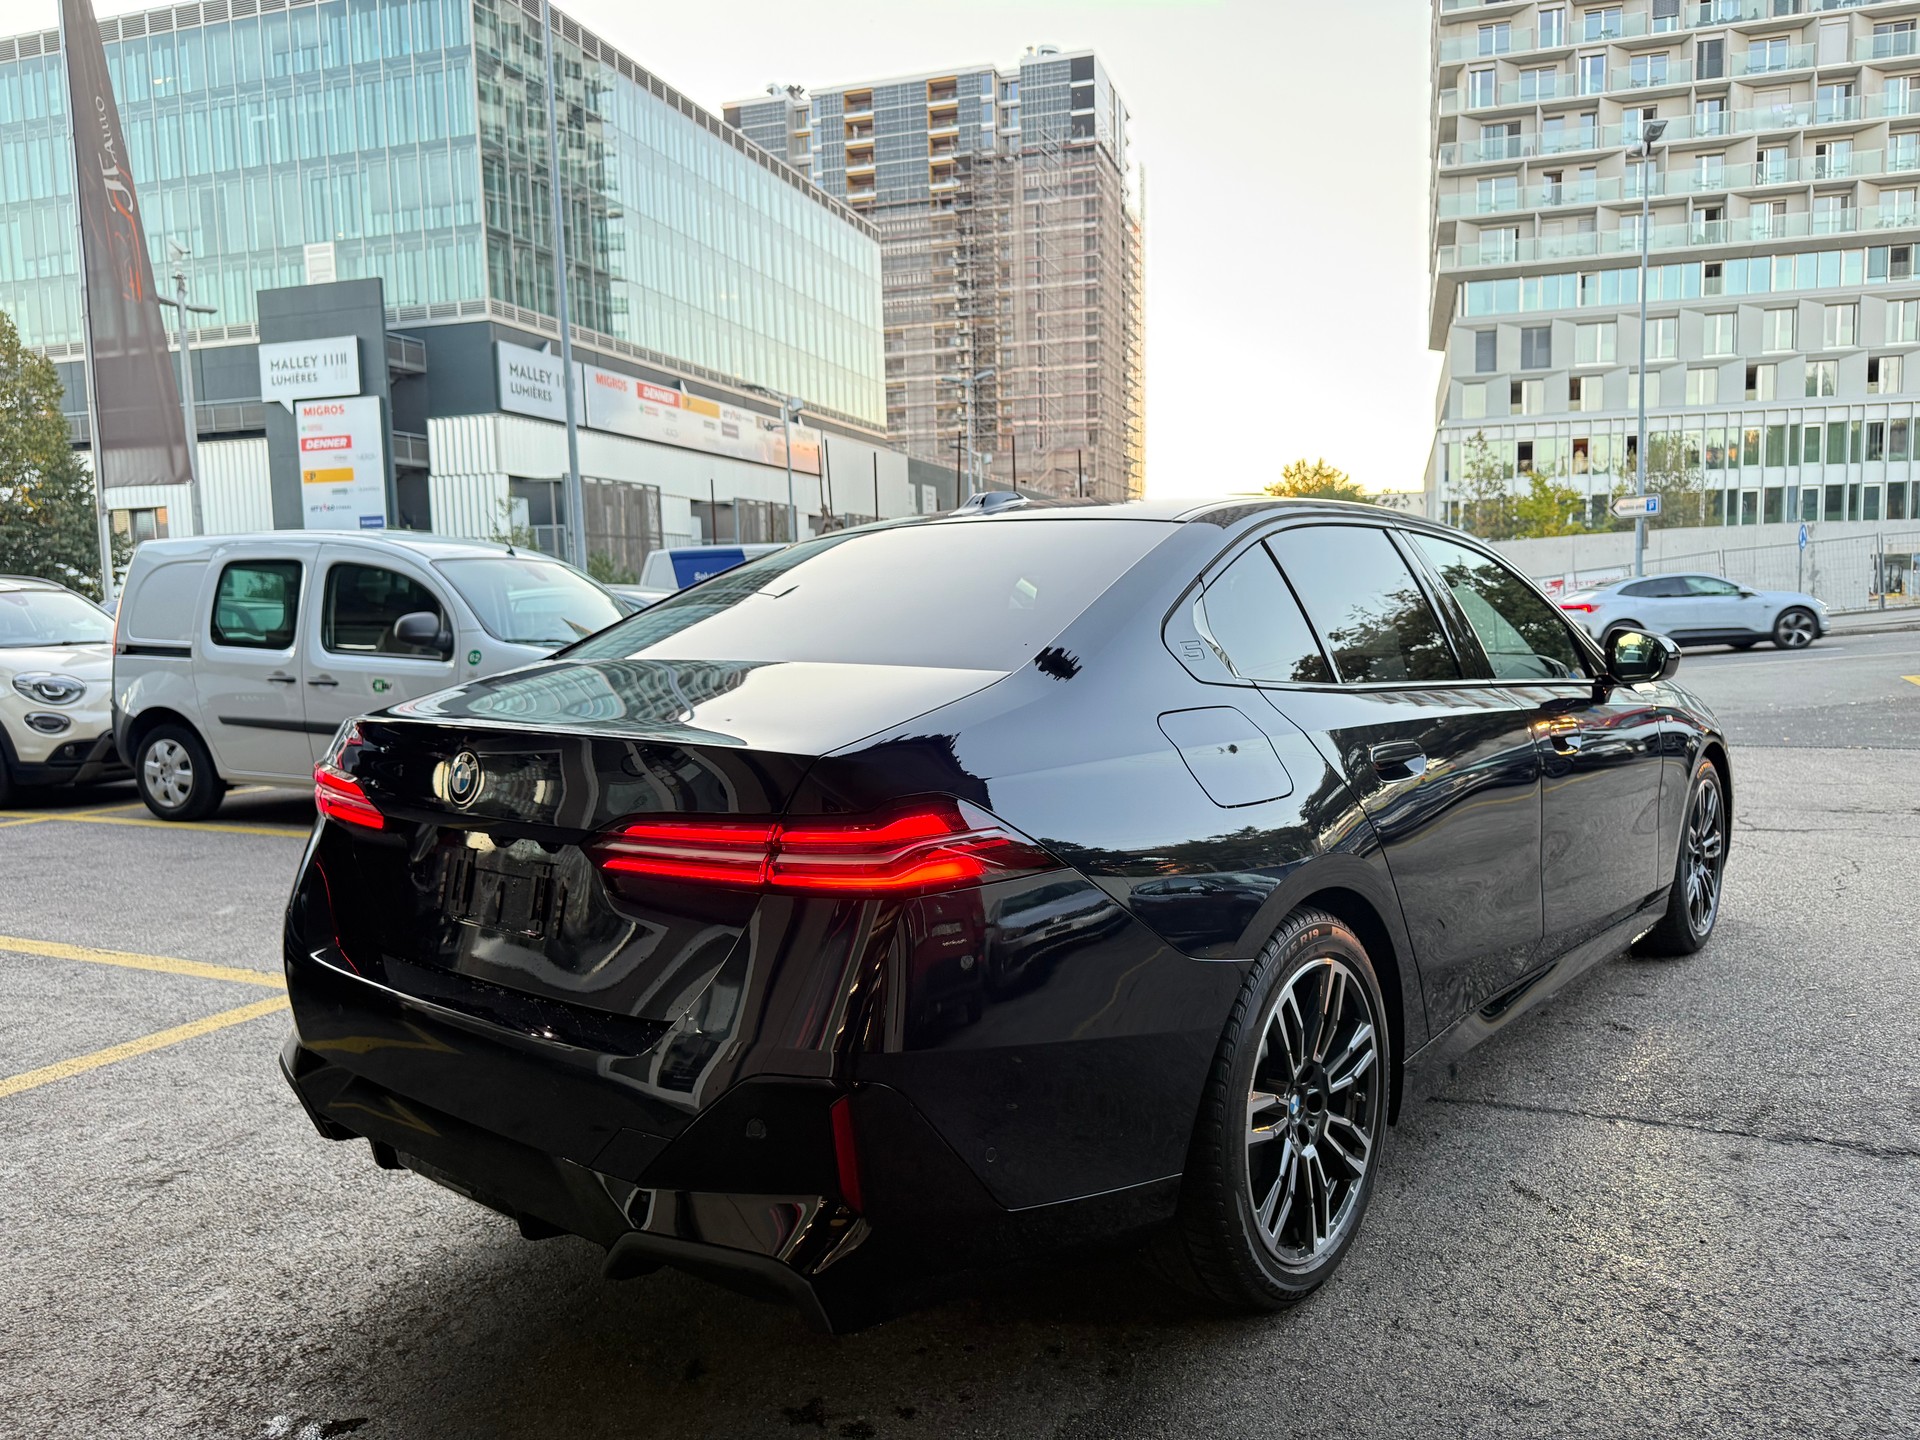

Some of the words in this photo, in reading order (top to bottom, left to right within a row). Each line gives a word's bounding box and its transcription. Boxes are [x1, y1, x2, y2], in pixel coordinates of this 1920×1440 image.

[270, 355, 318, 371] MALLEY
[271, 371, 318, 386] LUMIÈRES
[509, 363, 552, 386] MALLEY
[595, 373, 628, 393] MIGROS
[510, 382, 552, 402] LUMIÈRES
[643, 386, 675, 405] DENNER
[303, 404, 345, 417] MIGROS
[306, 438, 347, 450] DENNER
[1300, 928, 1319, 947] R19
